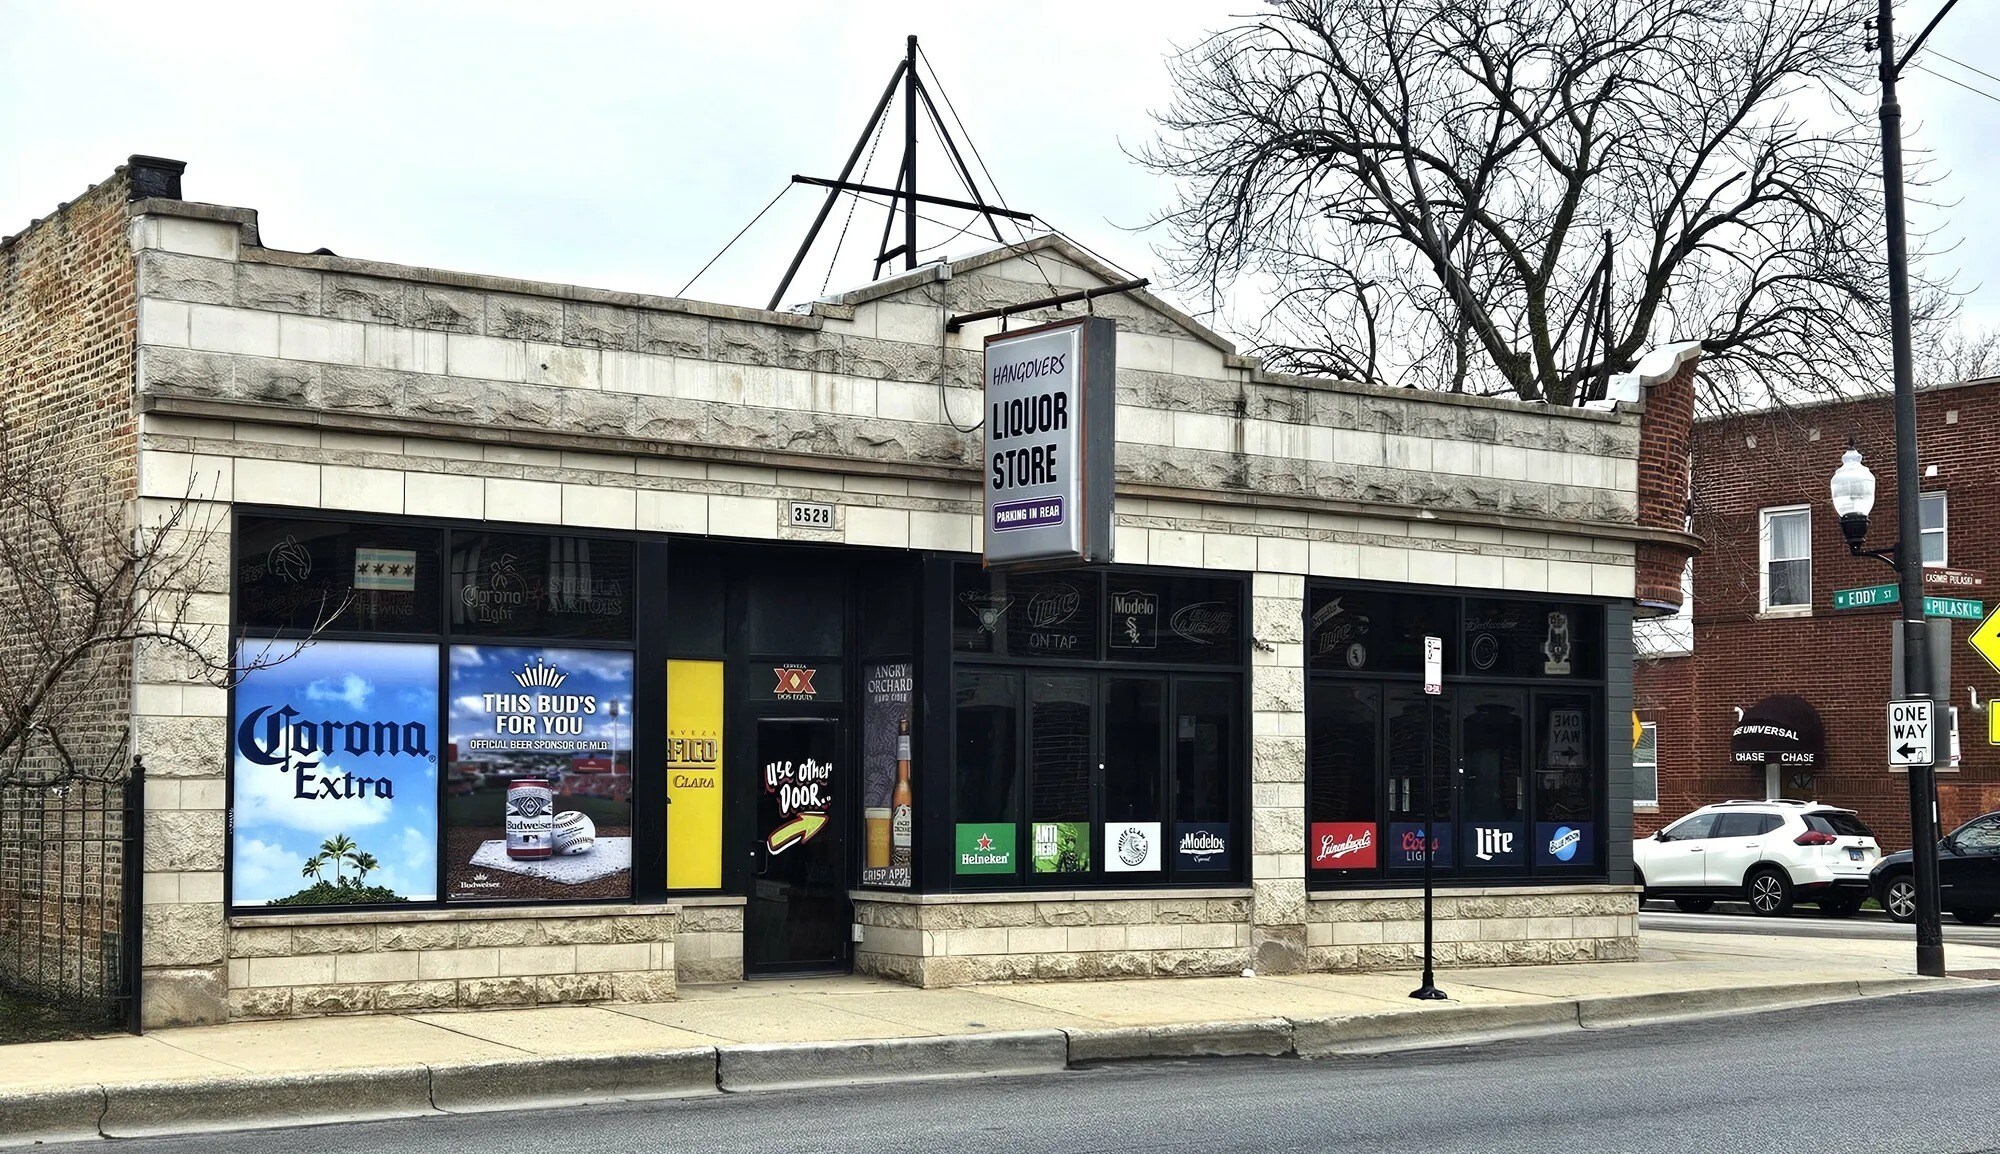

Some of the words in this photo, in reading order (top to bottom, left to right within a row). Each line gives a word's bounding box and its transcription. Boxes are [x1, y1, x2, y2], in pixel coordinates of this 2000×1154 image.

[992, 353, 1066, 386] HANGOVERS
[992, 391, 1067, 440] LIQUOR
[992, 444, 1057, 490] STORE
[794, 507, 828, 523] 3528
[997, 508, 1027, 523] PARKING
[1029, 506, 1037, 519] IN
[1040, 504, 1060, 518] REAR
[461, 584, 521, 608] Corona
[1849, 589, 1876, 605] EDDY
[1884, 590, 1891, 598] ST
[1114, 596, 1154, 615] Modelo
[1932, 600, 1973, 616] PULASKI
[1030, 633, 1050, 648] ON
[1053, 634, 1078, 649] TAP
[875, 664, 907, 679] ANGRY
[773, 668, 816, 694] XX
[868, 678, 913, 693] ORCHARD
[483, 694, 531, 714] THIS
[537, 694, 597, 715] BUD'S
[1893, 706, 1927, 721] ONE
[496, 715, 537, 734] FOR
[542, 716, 583, 735] YOU
[1743, 725, 1800, 741] UNIVERSAL
[1893, 724, 1928, 739] WAY
[237, 704, 431, 773] Corona
[470, 740, 508, 750] OFFICIAL
[510, 740, 533, 750] BEER
[534, 740, 575, 750] SPONSOR
[577, 741, 588, 750] OF
[1735, 752, 1765, 762] CHASE
[1781, 752, 1814, 762] CHASE
[293, 761, 394, 800] Extra
[1036, 825, 1058, 843] ANTI
[1118, 829, 1129, 852] WHITE
[1129, 827, 1146, 840] CLAW
[1183, 832, 1220, 849] Modelo
[1402, 831, 1439, 850] Coos
[1035, 842, 1058, 857] HERO
[1475, 827, 1513, 861] Lite
[962, 853, 1008, 865] Heineken
[863, 870, 887, 881] CRISP
[460, 881, 500, 889] Budweiser
